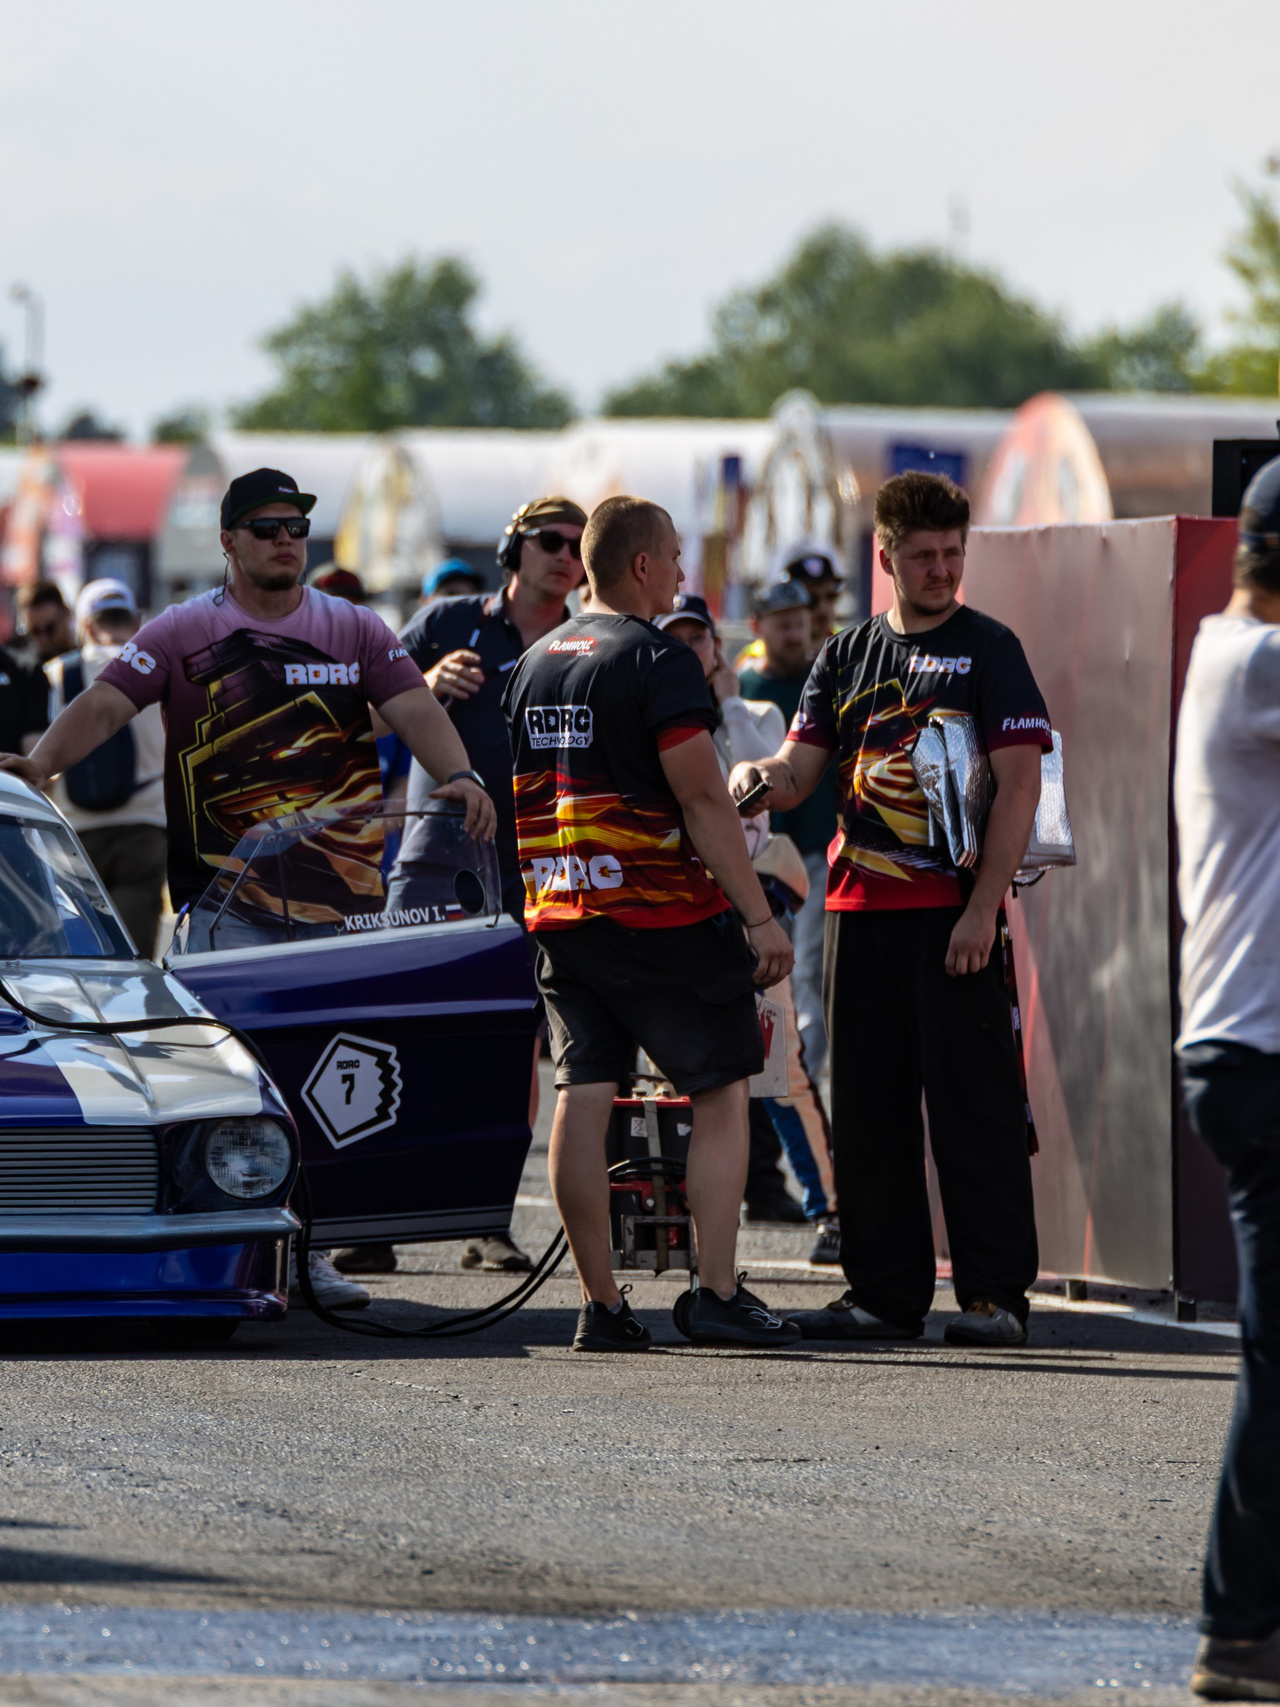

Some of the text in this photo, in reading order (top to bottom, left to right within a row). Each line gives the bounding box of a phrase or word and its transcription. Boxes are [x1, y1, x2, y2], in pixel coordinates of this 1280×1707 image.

[283, 662, 361, 686] RDRC
[526, 708, 591, 735] RDRC
[1002, 716, 1051, 732] FLAMHOL
[531, 854, 624, 894] RDRC
[344, 905, 446, 932] KRIKSUNOV I.
[336, 1060, 360, 1070] RDRC
[341, 1073, 355, 1106] 7
